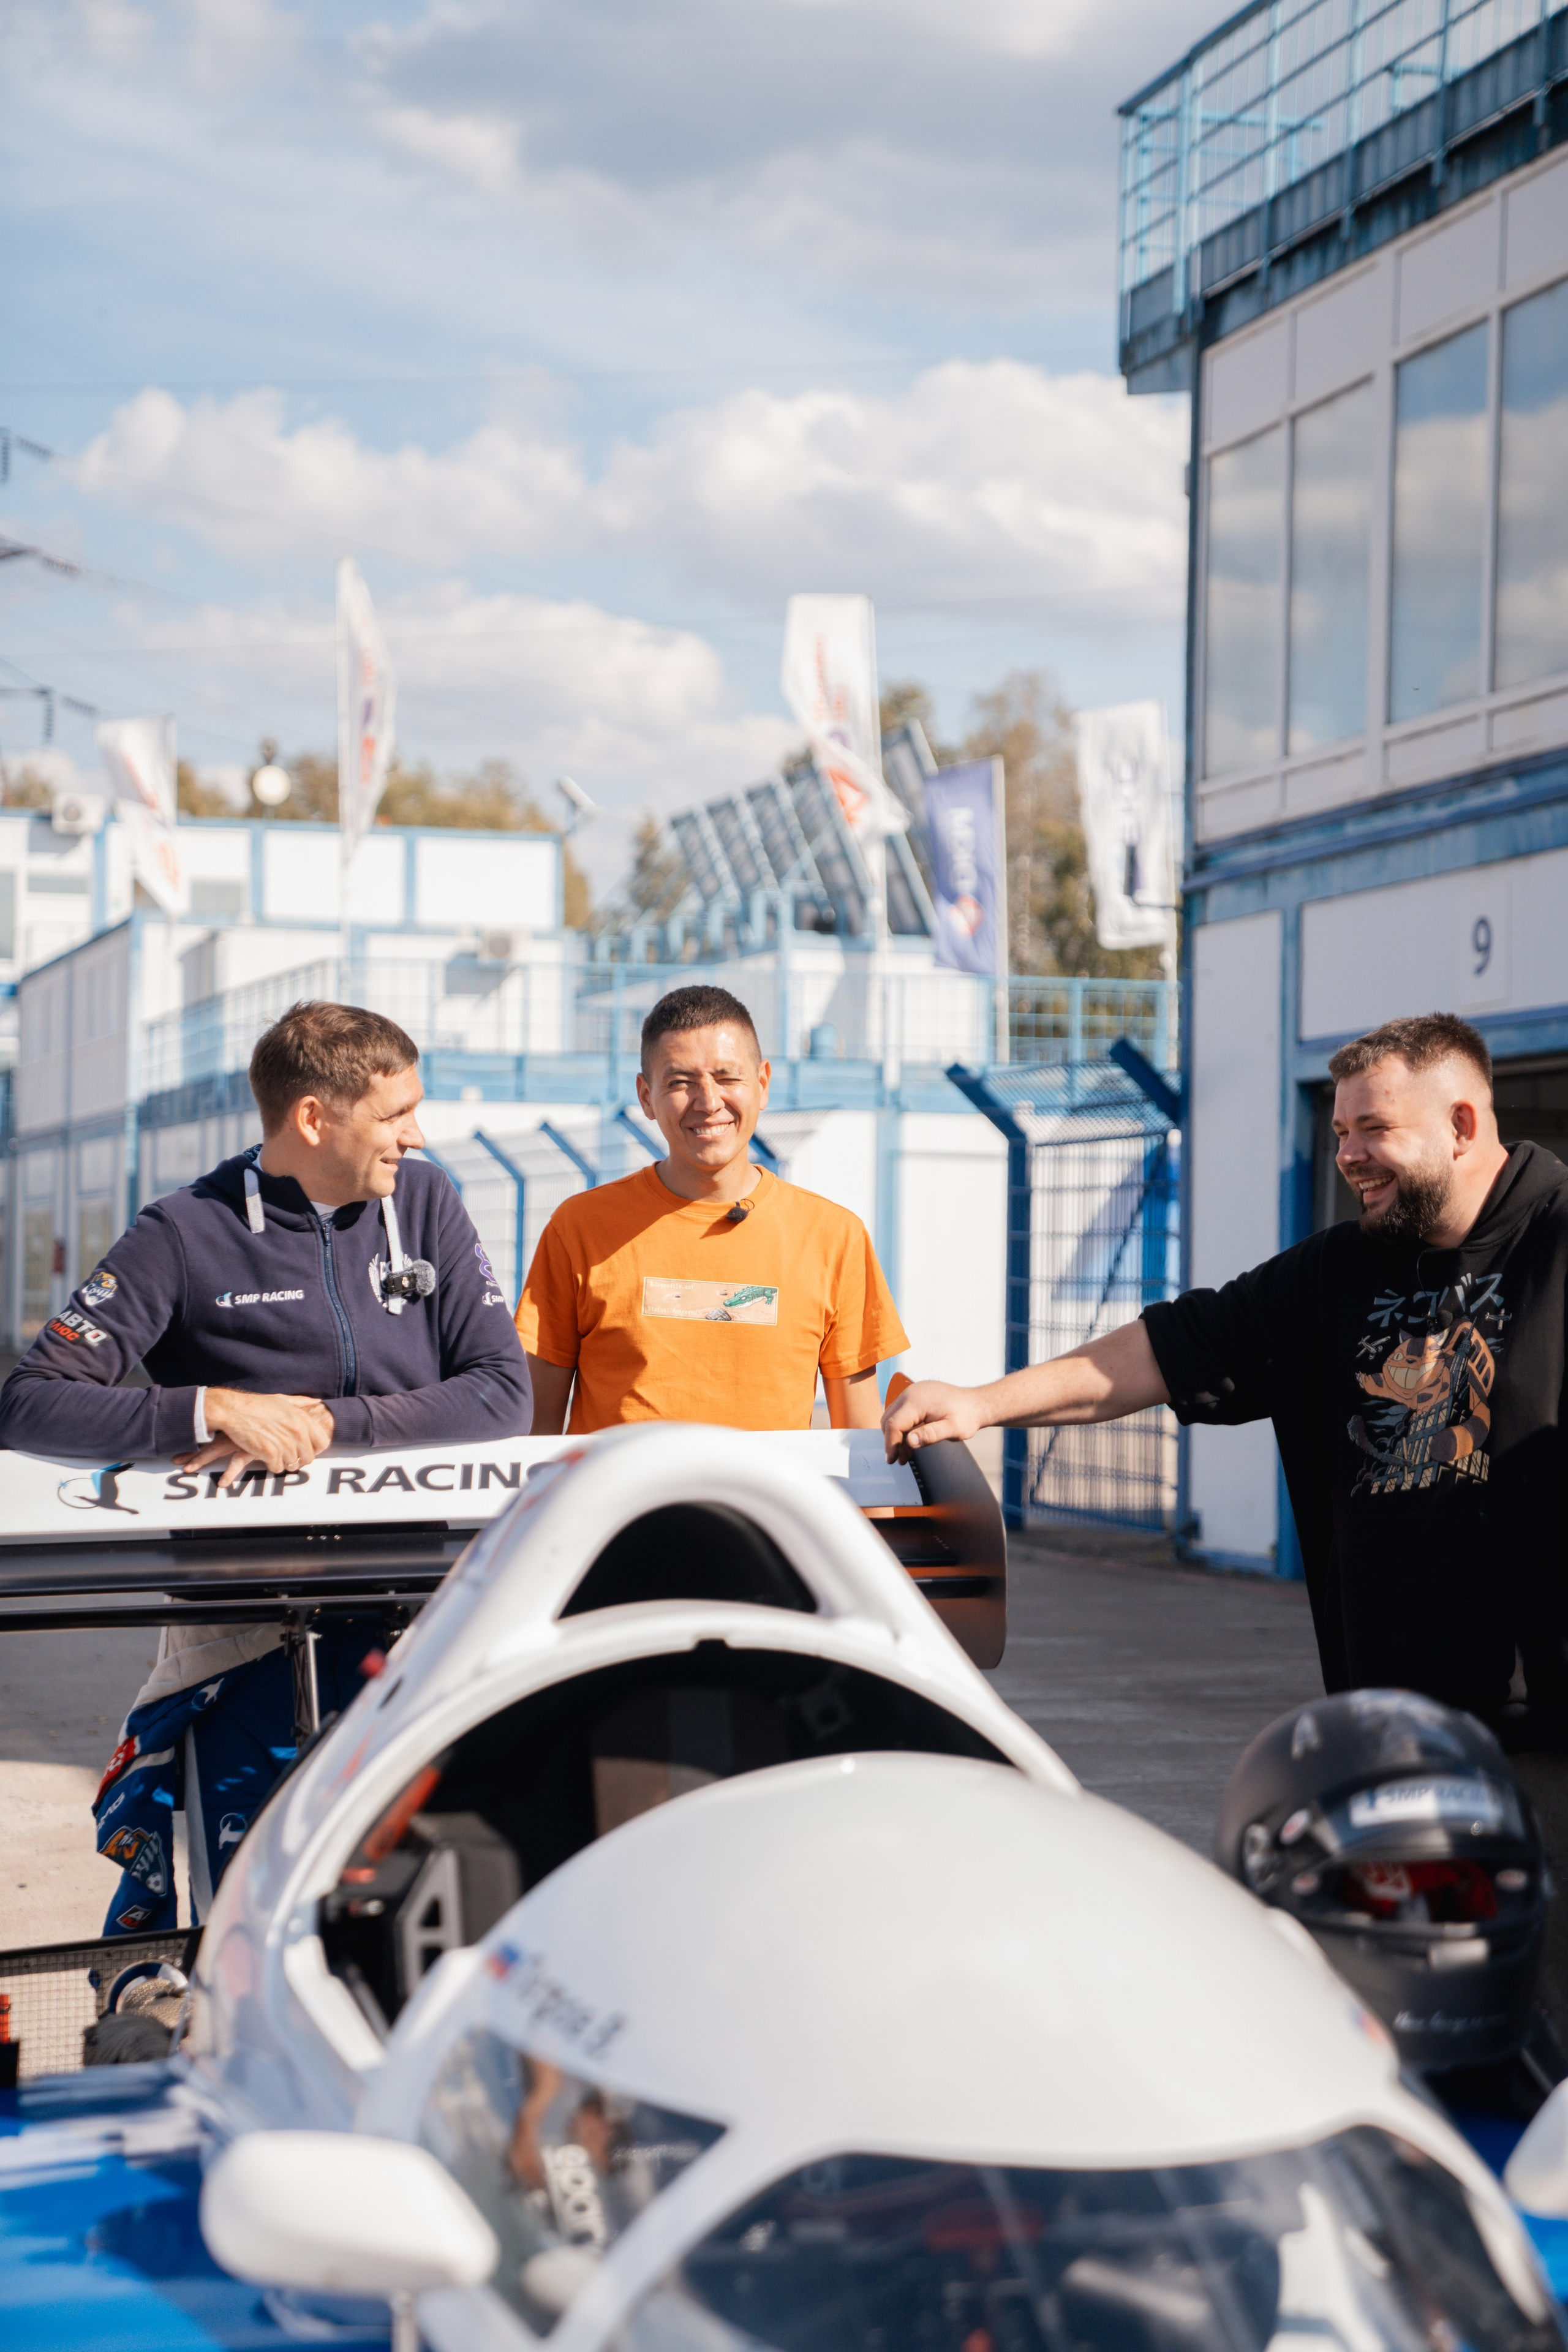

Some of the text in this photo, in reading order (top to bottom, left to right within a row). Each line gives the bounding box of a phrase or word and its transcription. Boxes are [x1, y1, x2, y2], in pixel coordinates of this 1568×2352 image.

[1472, 916, 1491, 975] 9
[235, 1289, 304, 1305] SMP RACING
[1367, 1273, 1504, 1327] ネコバス
[162, 1469, 310, 1499] SMP
